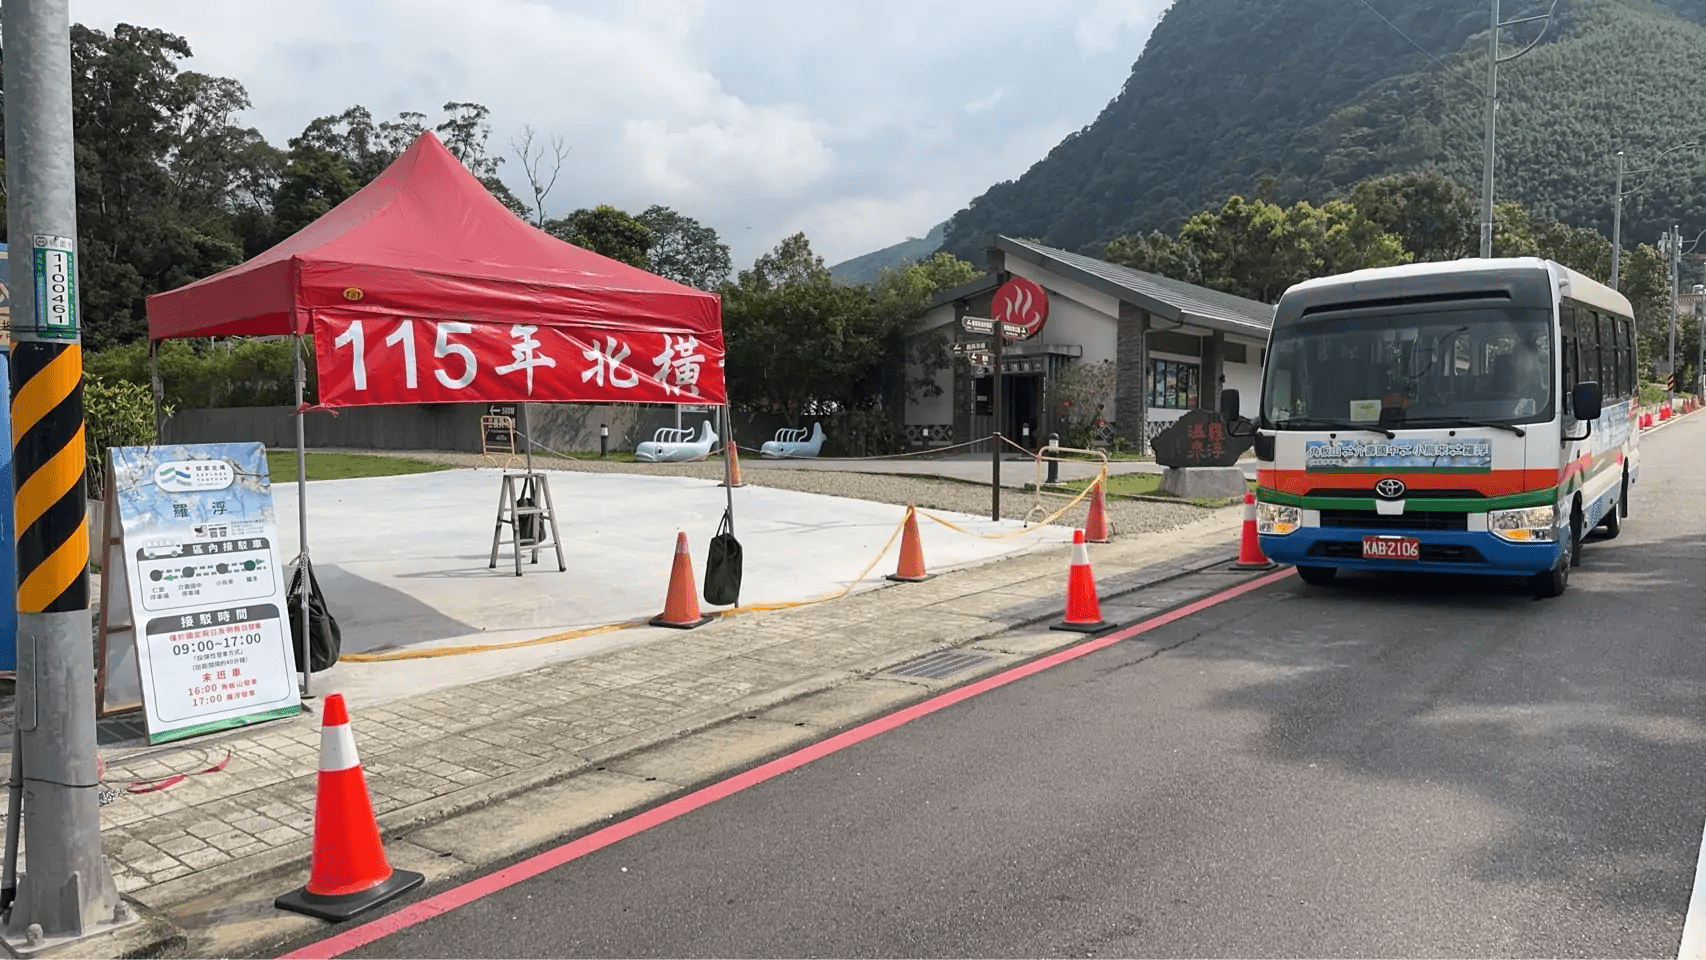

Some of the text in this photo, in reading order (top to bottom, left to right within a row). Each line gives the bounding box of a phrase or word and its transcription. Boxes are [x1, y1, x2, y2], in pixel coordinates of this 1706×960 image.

[52, 253, 65, 324] 1100461
[173, 501, 227, 518] 羅浮
[192, 539, 263, 555] 區內接駁車
[180, 608, 248, 628] 接駁時間
[173, 633, 261, 656] 09:00~17:00
[202, 668, 242, 682] 末班車
[188, 684, 218, 696] 16:00
[192, 694, 223, 707] 17:00
